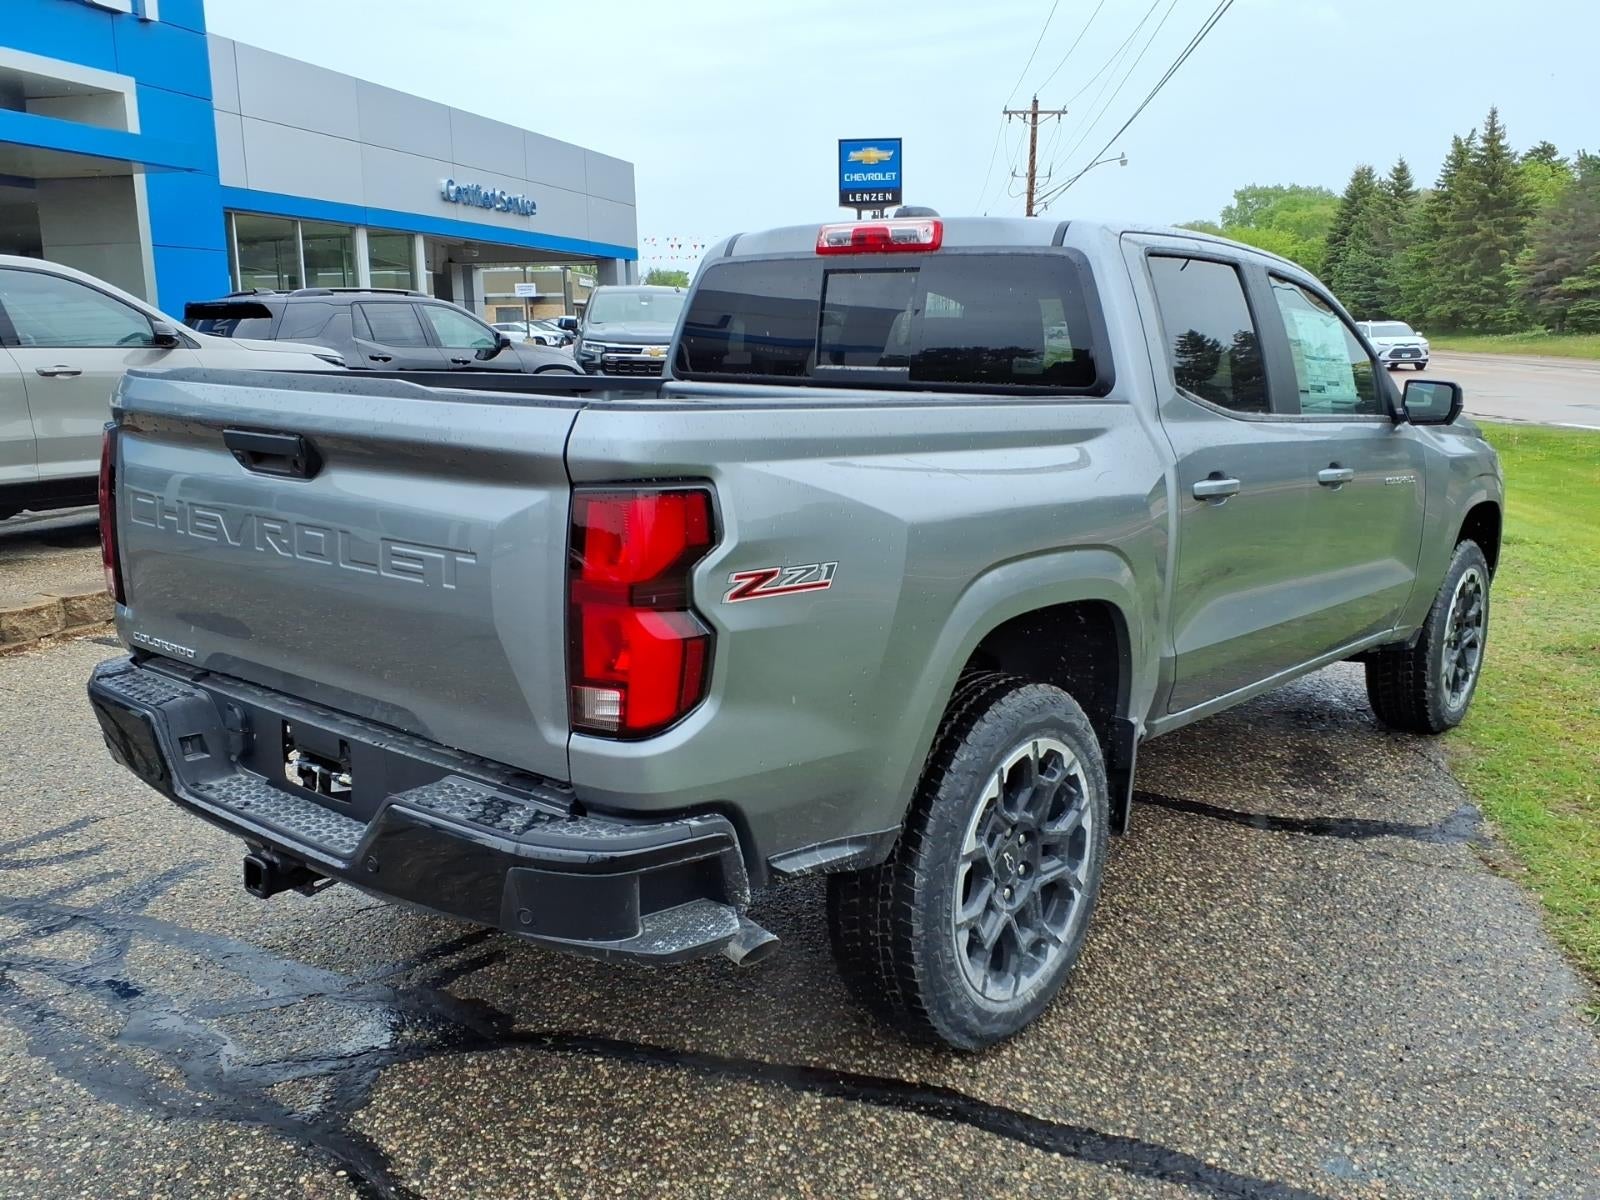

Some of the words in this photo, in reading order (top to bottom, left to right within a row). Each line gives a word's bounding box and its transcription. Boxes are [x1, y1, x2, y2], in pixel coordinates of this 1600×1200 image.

[844, 172, 896, 181] CHEVROLET
[441, 179, 496, 209] Certified
[496, 190, 537, 216] Service
[848, 193, 892, 201] LENZEN
[129, 490, 477, 588] CHEVROLET
[721, 561, 838, 604] Z71
[133, 631, 196, 658] COLORADO
